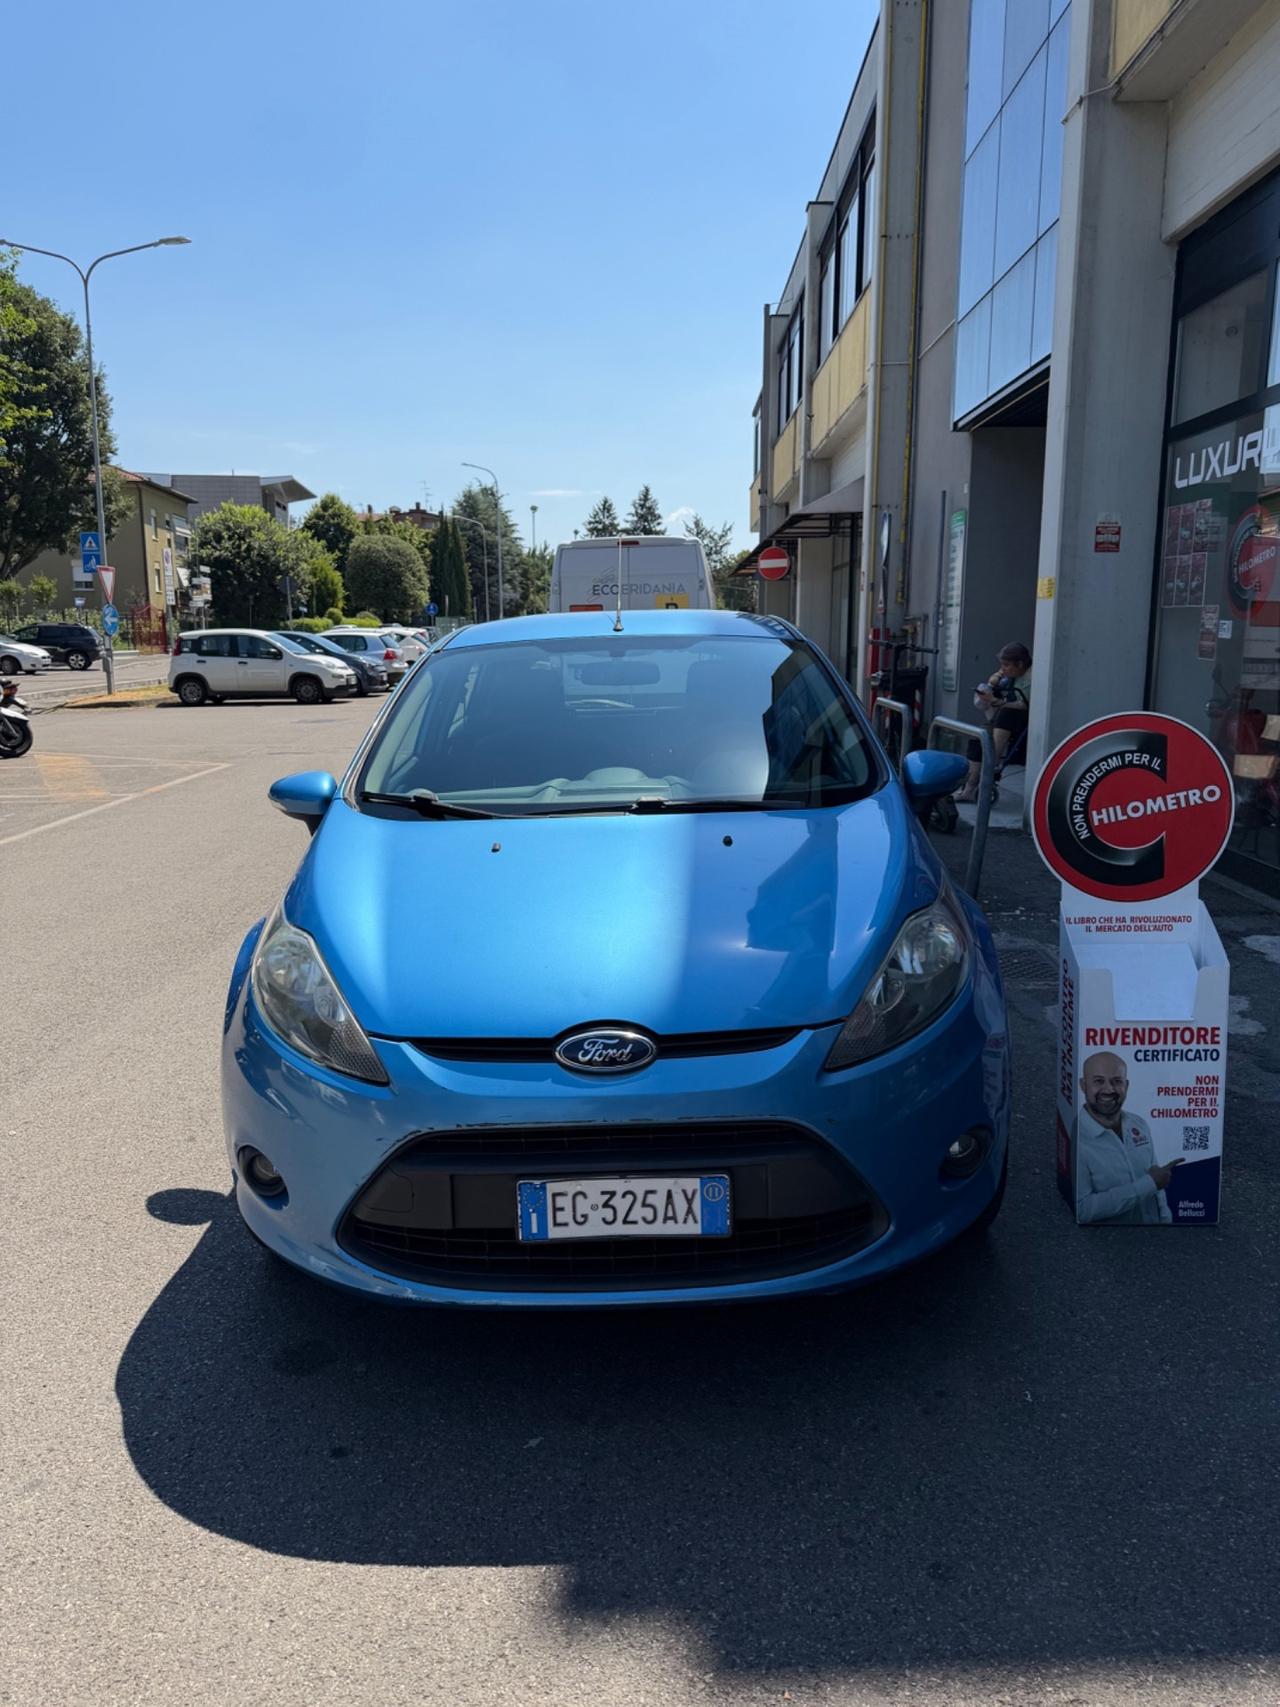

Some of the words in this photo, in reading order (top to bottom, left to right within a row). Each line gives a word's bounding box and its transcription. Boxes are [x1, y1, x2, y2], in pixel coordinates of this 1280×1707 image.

[1124, 752, 1150, 766] PER
[1151, 757, 1161, 771] IL
[1072, 754, 1122, 811] PRENDERMI
[1072, 814, 1091, 840] NON
[1065, 916, 1072, 925] IL
[1074, 916, 1097, 925] LIBRO
[1098, 916, 1115, 925] CHE
[1115, 916, 1127, 924] HA
[1129, 915, 1193, 924] RIVOLUZIONATO
[1085, 925, 1093, 933] IL
[1095, 925, 1132, 933] MERCATO
[1133, 924, 1174, 932] DELL'AUTO
[1085, 1026, 1221, 1046] RIVENDITORE
[578, 1038, 633, 1062] Ford
[1134, 1048, 1220, 1062] CERTIFICATO
[1195, 1075, 1219, 1085] NON
[1157, 1086, 1219, 1096] PRENDERMI
[1188, 1097, 1207, 1107] PER
[1150, 1108, 1218, 1118] CHILOMETRO
[1179, 1200, 1204, 1209] Alfredo
